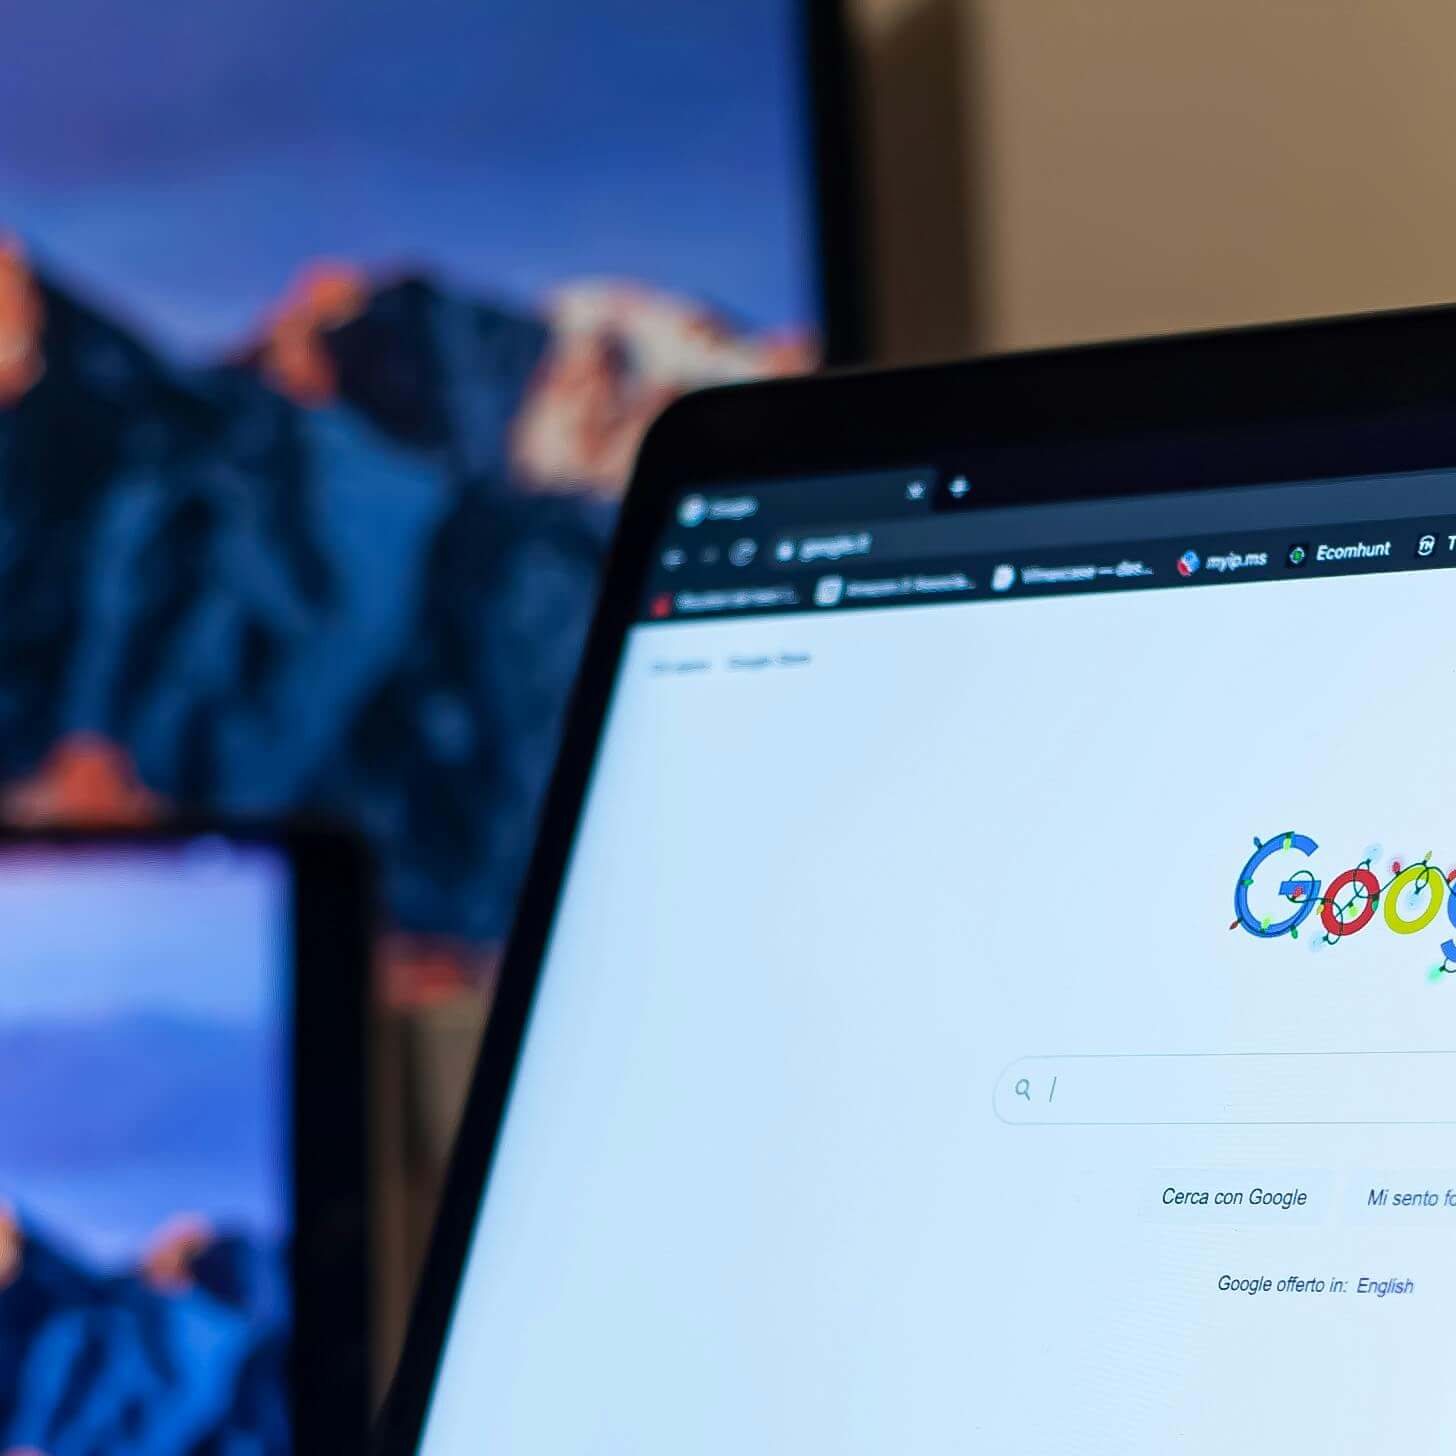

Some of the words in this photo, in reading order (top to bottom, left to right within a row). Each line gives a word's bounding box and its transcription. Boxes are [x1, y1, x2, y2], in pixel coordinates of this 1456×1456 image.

[1316, 541, 1391, 561] Ecomhunt
[1162, 1187, 1208, 1205] Cerca
[1214, 1190, 1243, 1205] con
[1249, 1187, 1307, 1209] Google
[1368, 1188, 1387, 1206] Mi
[1392, 1190, 1438, 1206] sento
[1218, 1275, 1272, 1295] Google
[1276, 1275, 1324, 1293] offerto
[1329, 1277, 1348, 1294] in:
[1356, 1277, 1414, 1298] English
